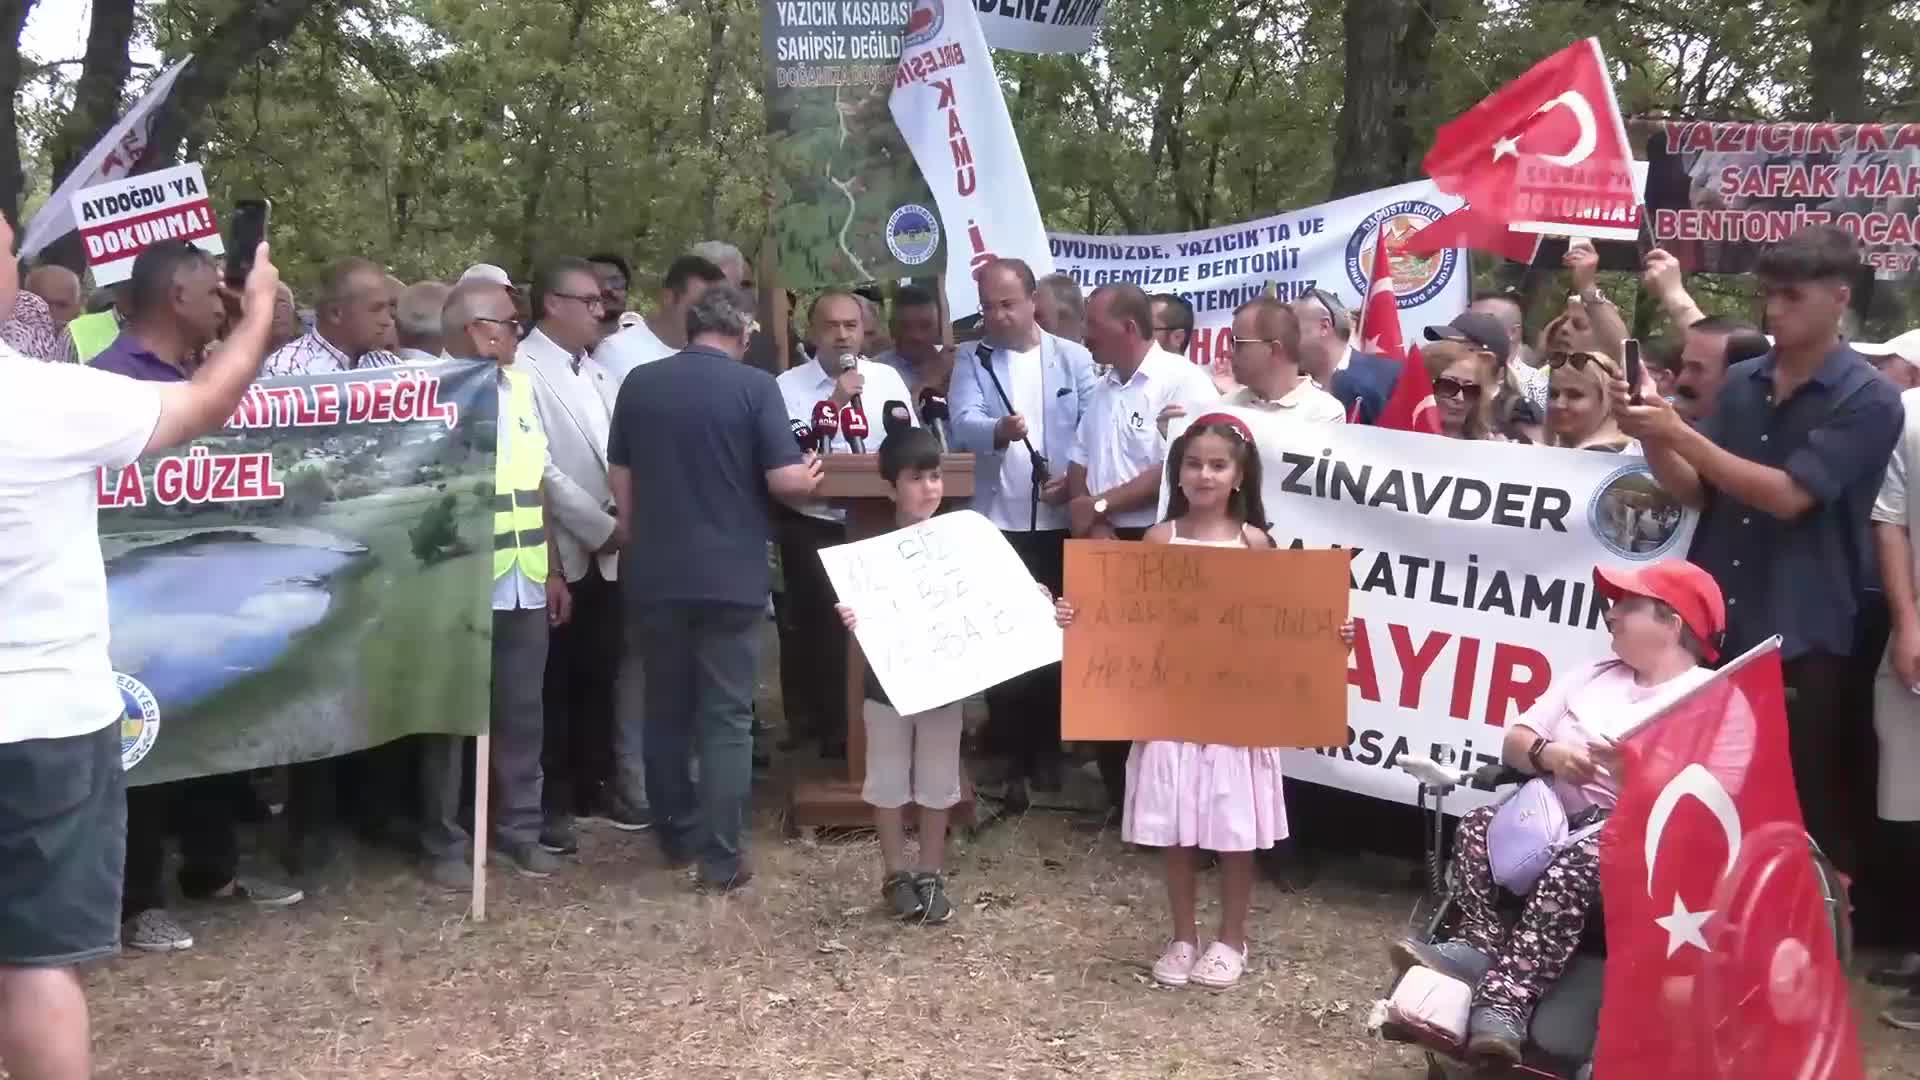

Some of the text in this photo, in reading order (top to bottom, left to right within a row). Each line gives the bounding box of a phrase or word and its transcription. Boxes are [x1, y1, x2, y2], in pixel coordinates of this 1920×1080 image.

[776, 1, 838, 27] YAZICIK
[777, 31, 846, 61] SAHİPSİZ
[1665, 122, 1841, 154] YAZICIK
[81, 184, 165, 222] AYDOĞDU
[1719, 164, 1840, 204] ŞAFAK
[86, 206, 213, 259] DOKUNMA!
[1178, 222, 1291, 258] YAZICIK'TA
[1299, 217, 1325, 237] VE
[1197, 246, 1301, 280] BENTONİT
[345, 370, 458, 430] DEĞİL,
[154, 446, 284, 505] GÜZEL
[1280, 447, 1573, 533] ZİNAVDER
[1347, 616, 1553, 728] AYIR
